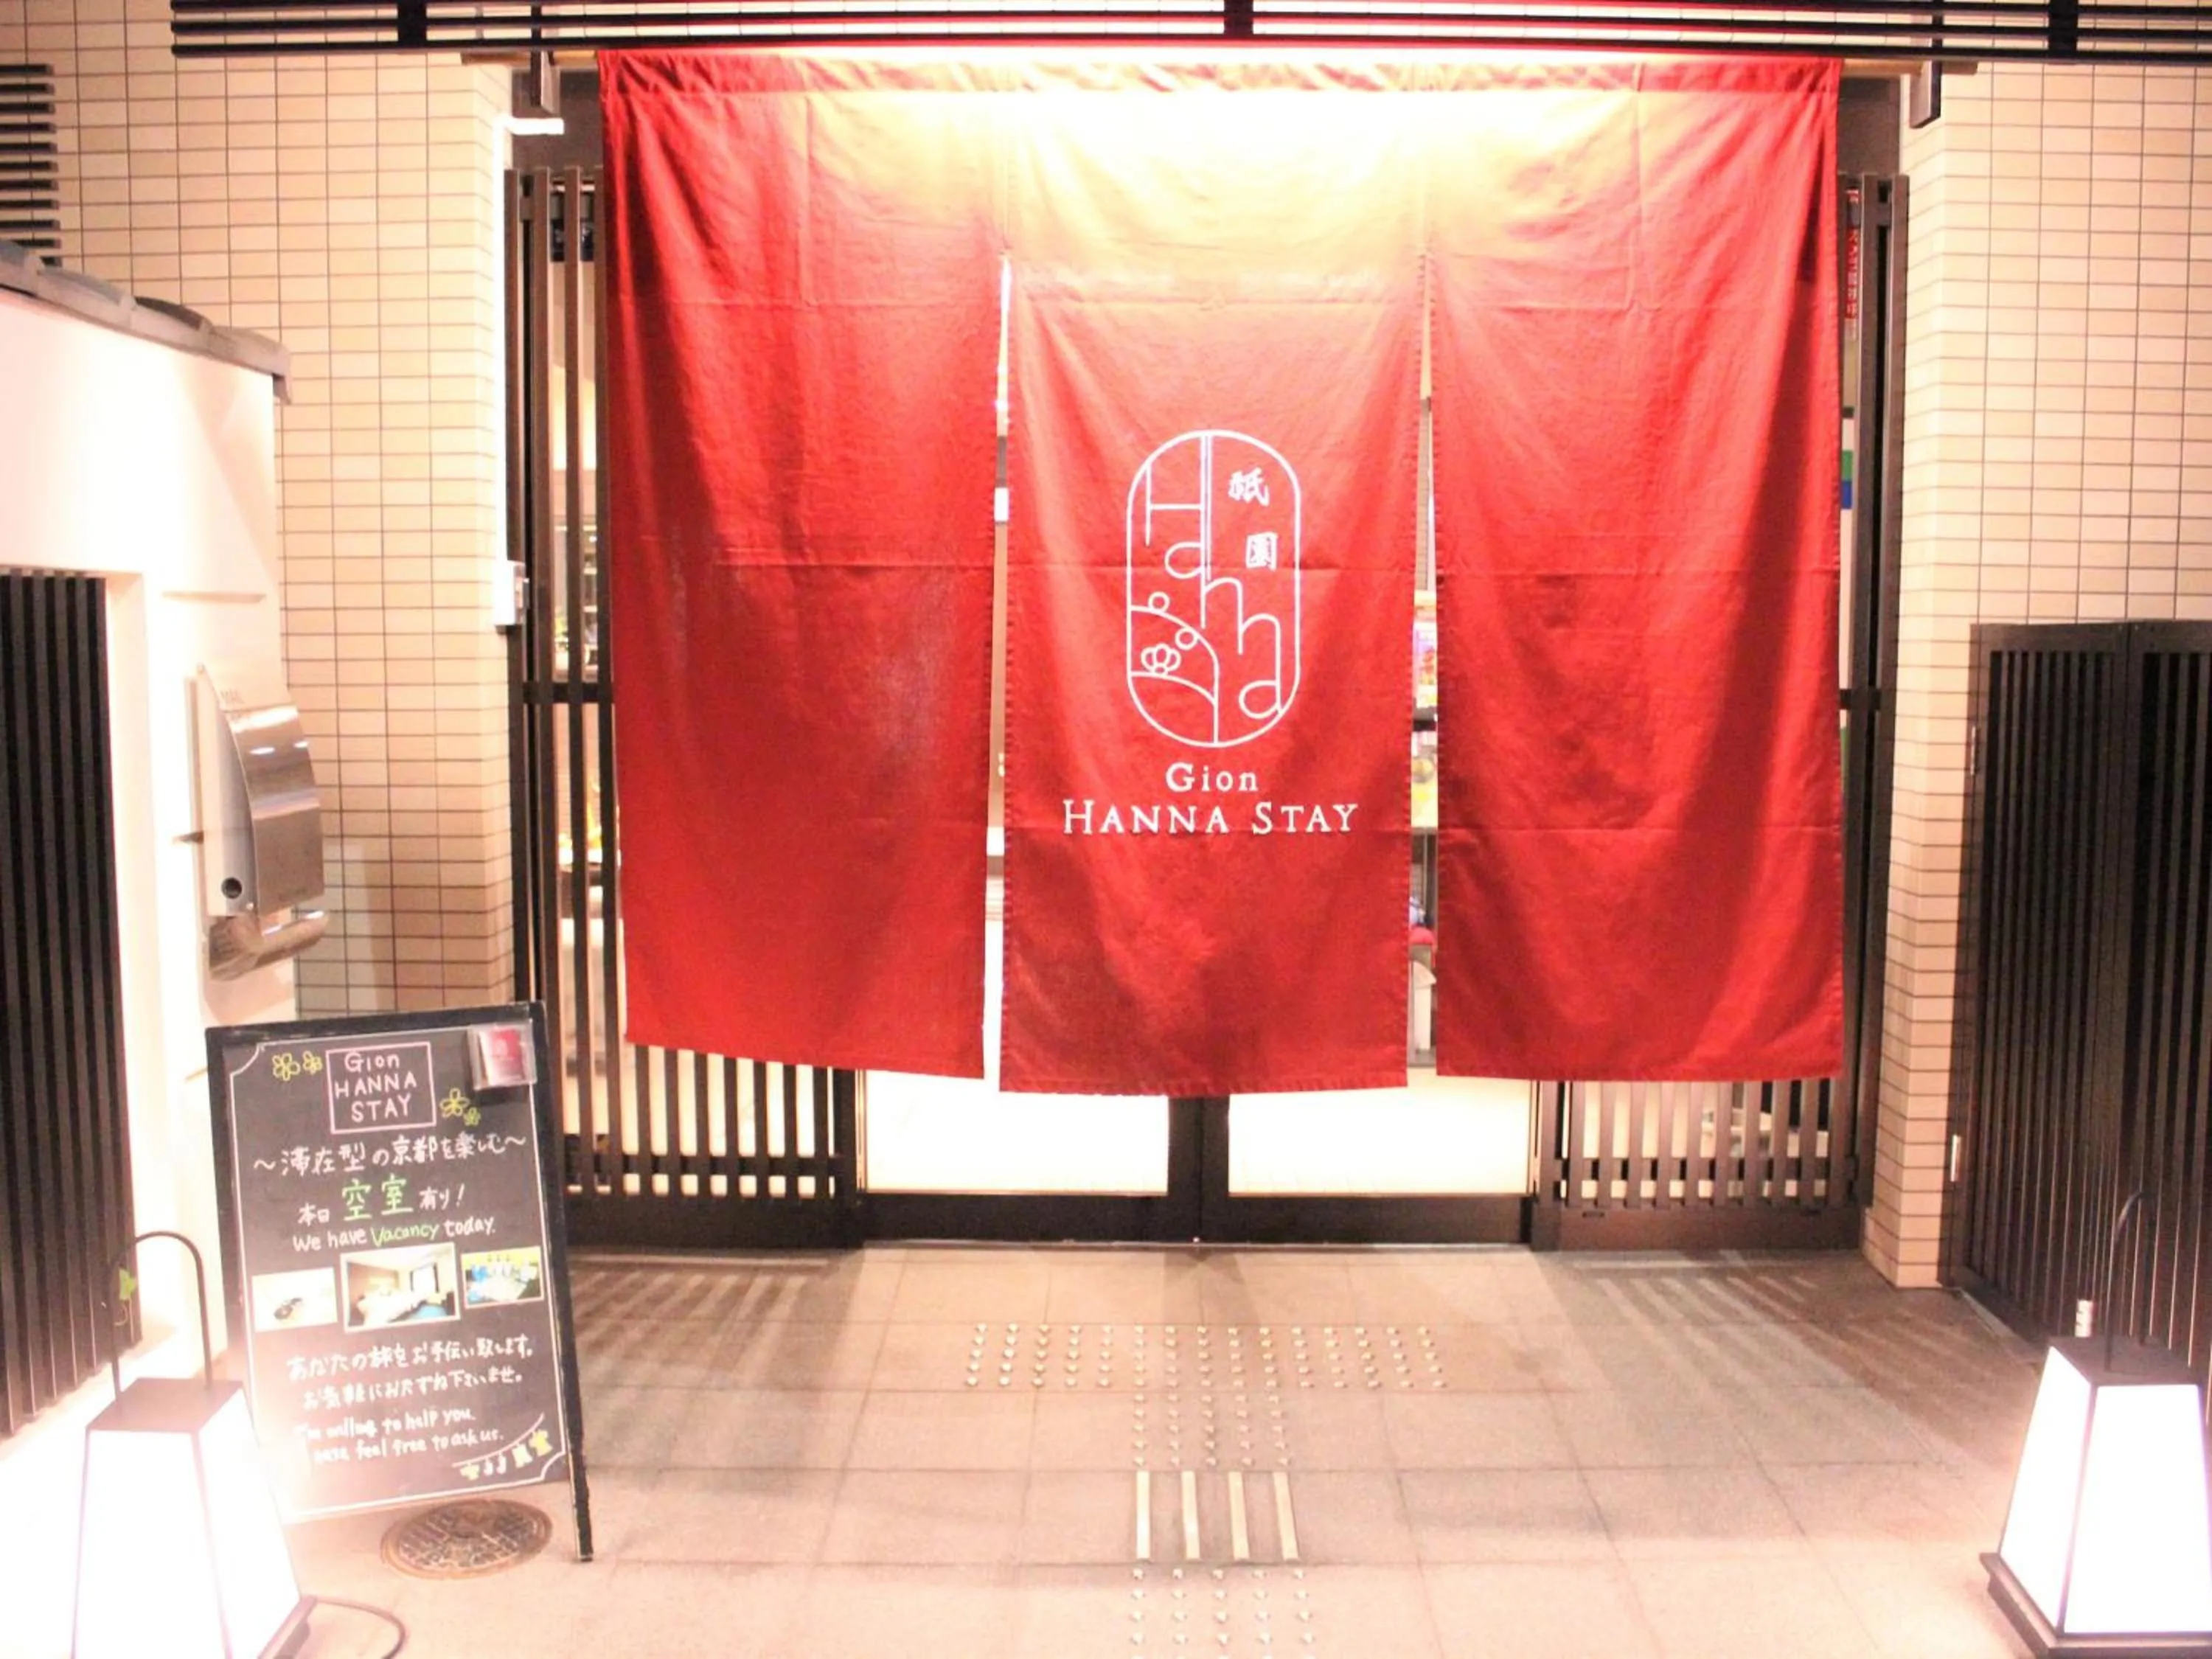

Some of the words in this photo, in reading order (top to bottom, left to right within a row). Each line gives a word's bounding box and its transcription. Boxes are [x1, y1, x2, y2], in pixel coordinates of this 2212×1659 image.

[1166, 762, 1258, 793] Gion
[1062, 799, 1229, 835] HANNA
[1253, 801, 1358, 835] STAY
[344, 1052, 400, 1071] Gion
[335, 1071, 417, 1098] HANNA
[351, 1095, 411, 1122] STAY
[293, 1232, 321, 1252] We
[327, 1228, 367, 1248] have
[445, 1217, 496, 1236] today.
[381, 1417, 402, 1435] to
[405, 1408, 439, 1430] help
[392, 1439, 427, 1457] free
[431, 1434, 449, 1452] to
